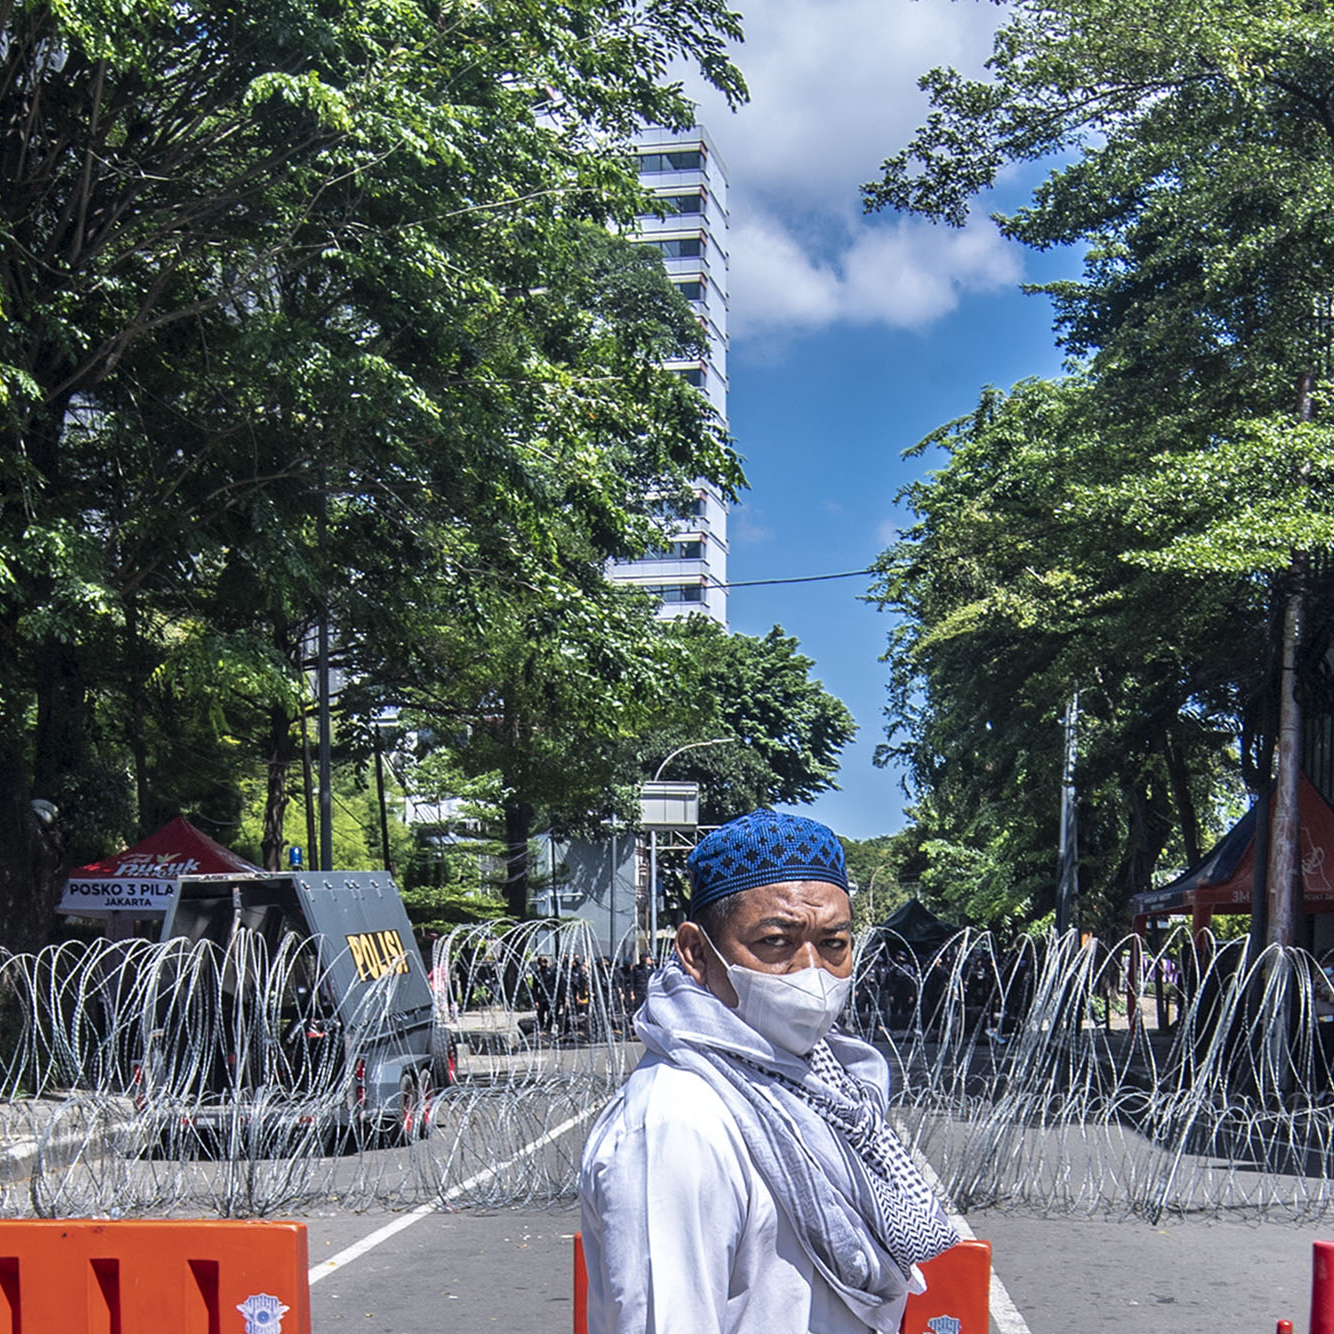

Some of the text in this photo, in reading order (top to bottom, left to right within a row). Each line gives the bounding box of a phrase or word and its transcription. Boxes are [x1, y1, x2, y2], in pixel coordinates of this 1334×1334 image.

[69, 884, 175, 896] POSKO 3 PILA
[105, 898, 152, 907] JAKARTA
[346, 930, 409, 982] POLISI
